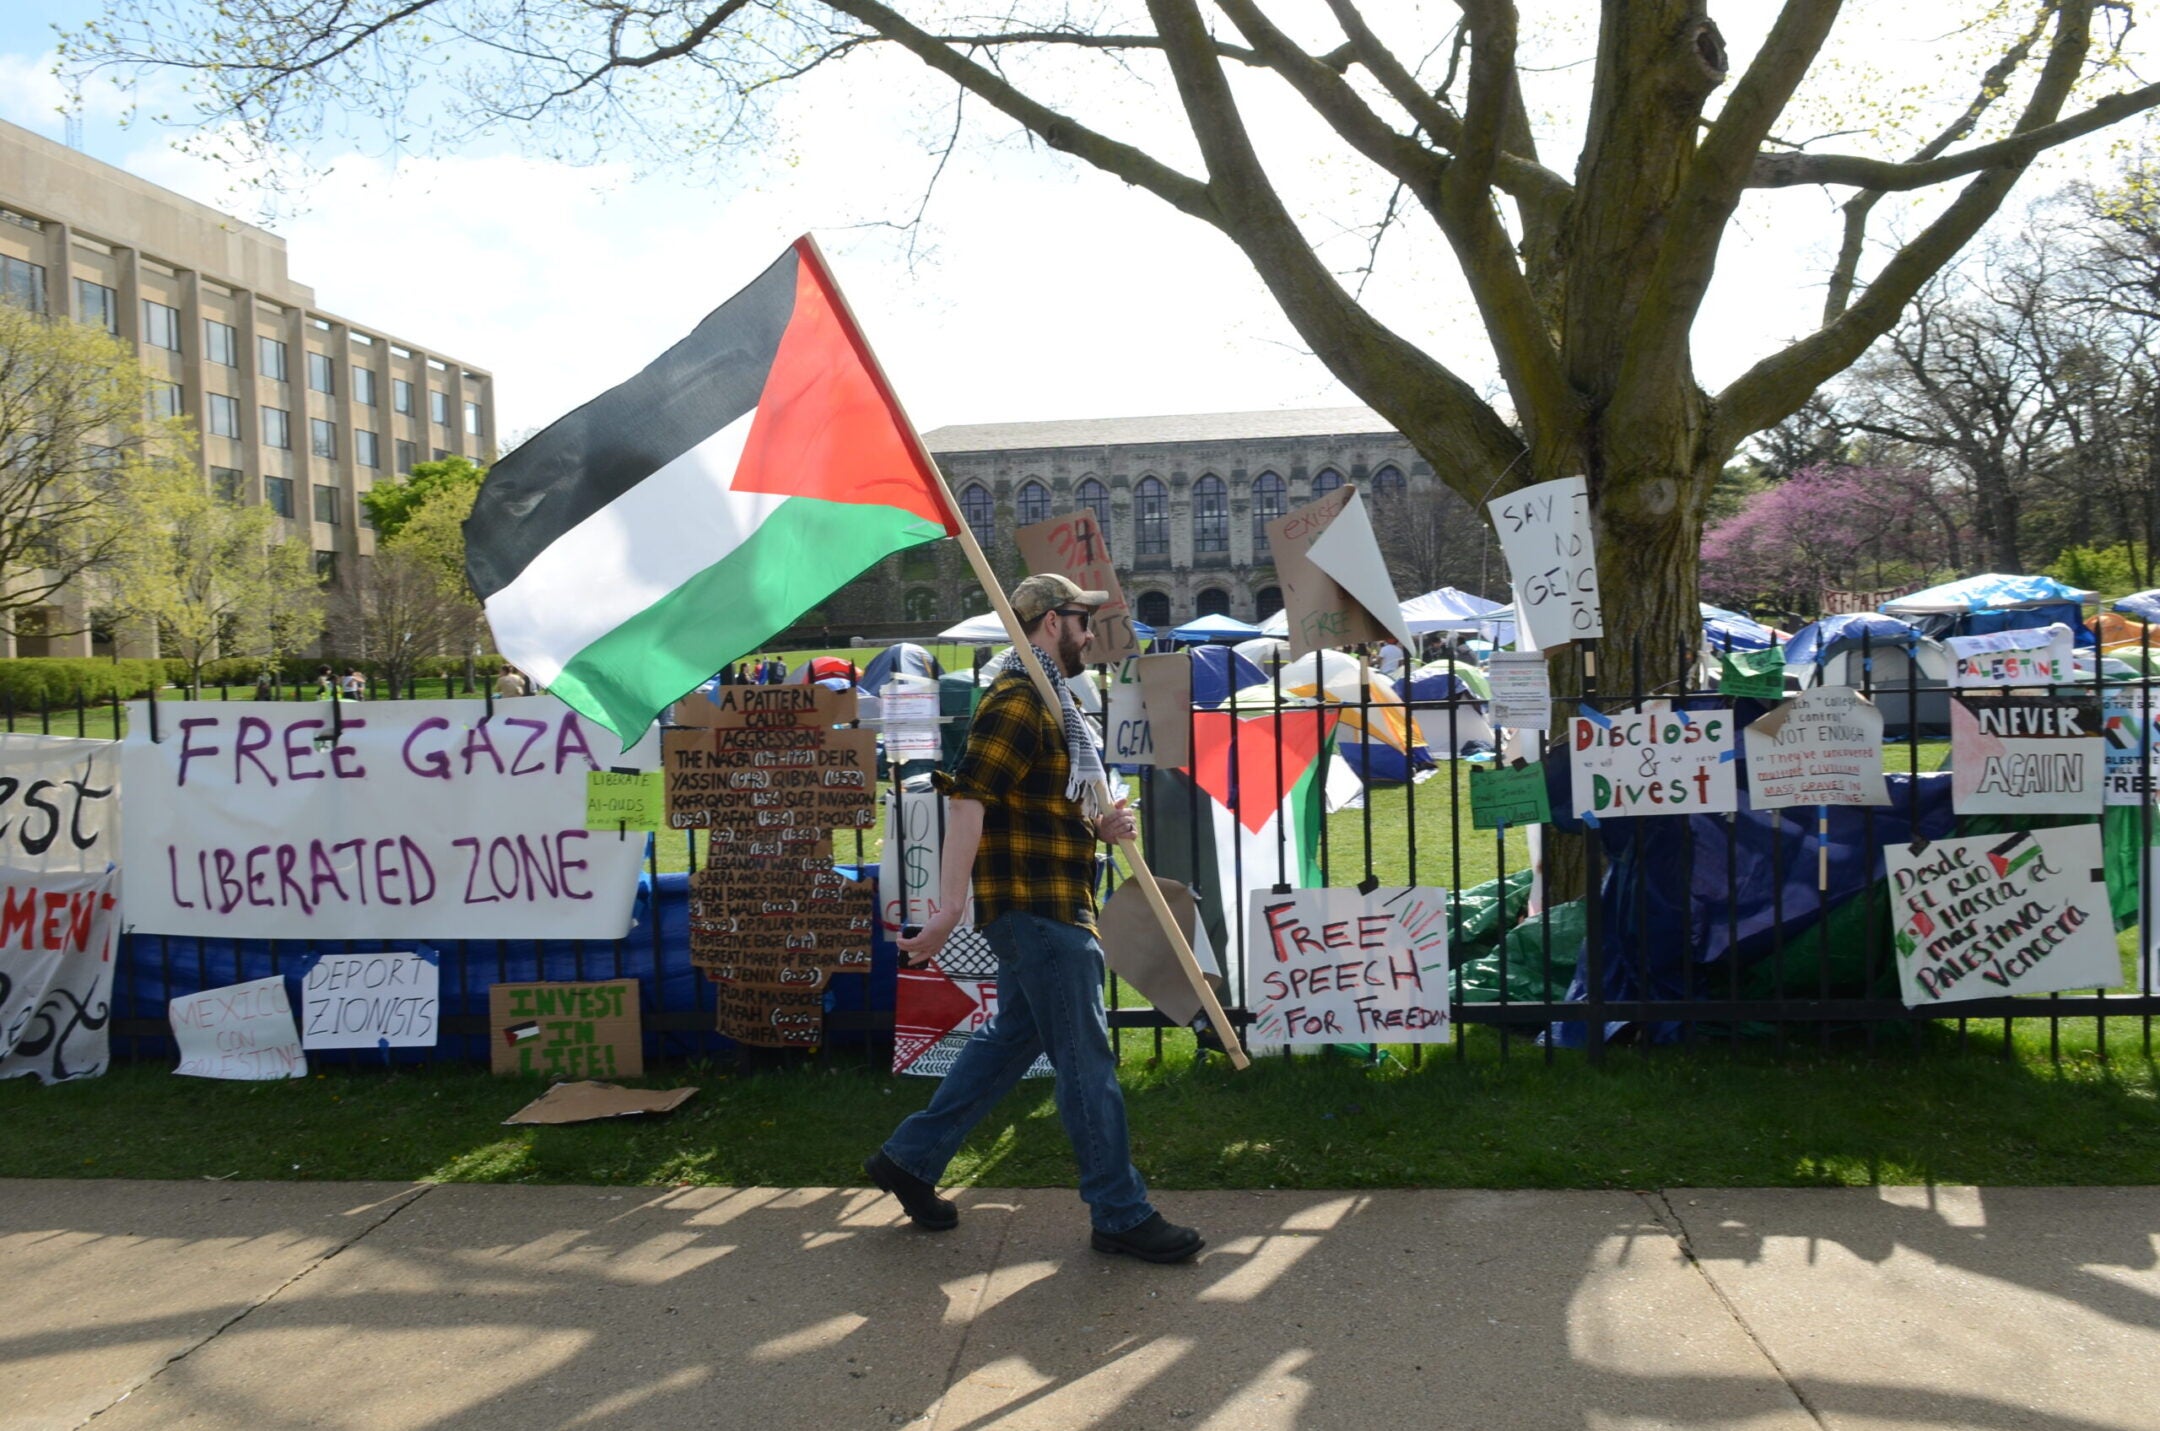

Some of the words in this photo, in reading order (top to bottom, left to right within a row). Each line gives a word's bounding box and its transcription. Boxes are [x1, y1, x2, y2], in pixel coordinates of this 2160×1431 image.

[1503, 495, 1552, 532] SAY
[1957, 658, 2063, 681] PALESTINE
[721, 690, 737, 711] A
[744, 690, 814, 710] PATTERN
[746, 713, 797, 727] CALLED
[1979, 706, 2085, 736] NEVER
[178, 716, 366, 786] FREE
[402, 712, 601, 780] GAZA
[1772, 728, 1807, 747] NOT
[1817, 725, 1864, 743] ENOUGH
[676, 750, 702, 768] THE
[707, 751, 751, 767] NAKBA
[818, 749, 859, 767] DEIR
[1638, 747, 1660, 777] &
[593, 774, 650, 786] LIBERATE
[671, 772, 729, 791] YASSIN
[772, 771, 820, 788] QIBYA
[1593, 766, 1710, 810] Divest
[1764, 784, 1795, 796] MASS
[1849, 782, 1862, 791] IN
[1976, 753, 2083, 797] AGAIN
[672, 794, 705, 809] KAFR
[818, 791, 875, 806] INVASION
[711, 810, 756, 826] RAFAH
[784, 843, 816, 856] FIRST
[168, 834, 437, 915] LIBERATED
[452, 829, 593, 905] ZONE
[699, 872, 734, 885] SABRA
[1894, 846, 1975, 896] Desde
[727, 887, 767, 901] BONES
[1938, 882, 2027, 929] Hasta
[2029, 854, 2063, 883] el
[704, 903, 723, 917] THE
[1263, 901, 1395, 963] FREE
[1926, 919, 1979, 962] mar
[308, 957, 424, 991] DEPORT
[1264, 949, 1423, 1001] SPEECH
[171, 983, 291, 1034] MEXICO
[307, 996, 435, 1037] ZIONISTS
[509, 985, 627, 1018] INVEST
[546, 1021, 594, 1047] IN
[1285, 1006, 1343, 1038] FOR
[216, 1031, 255, 1053] CON
[520, 1045, 617, 1077] LIFE!
